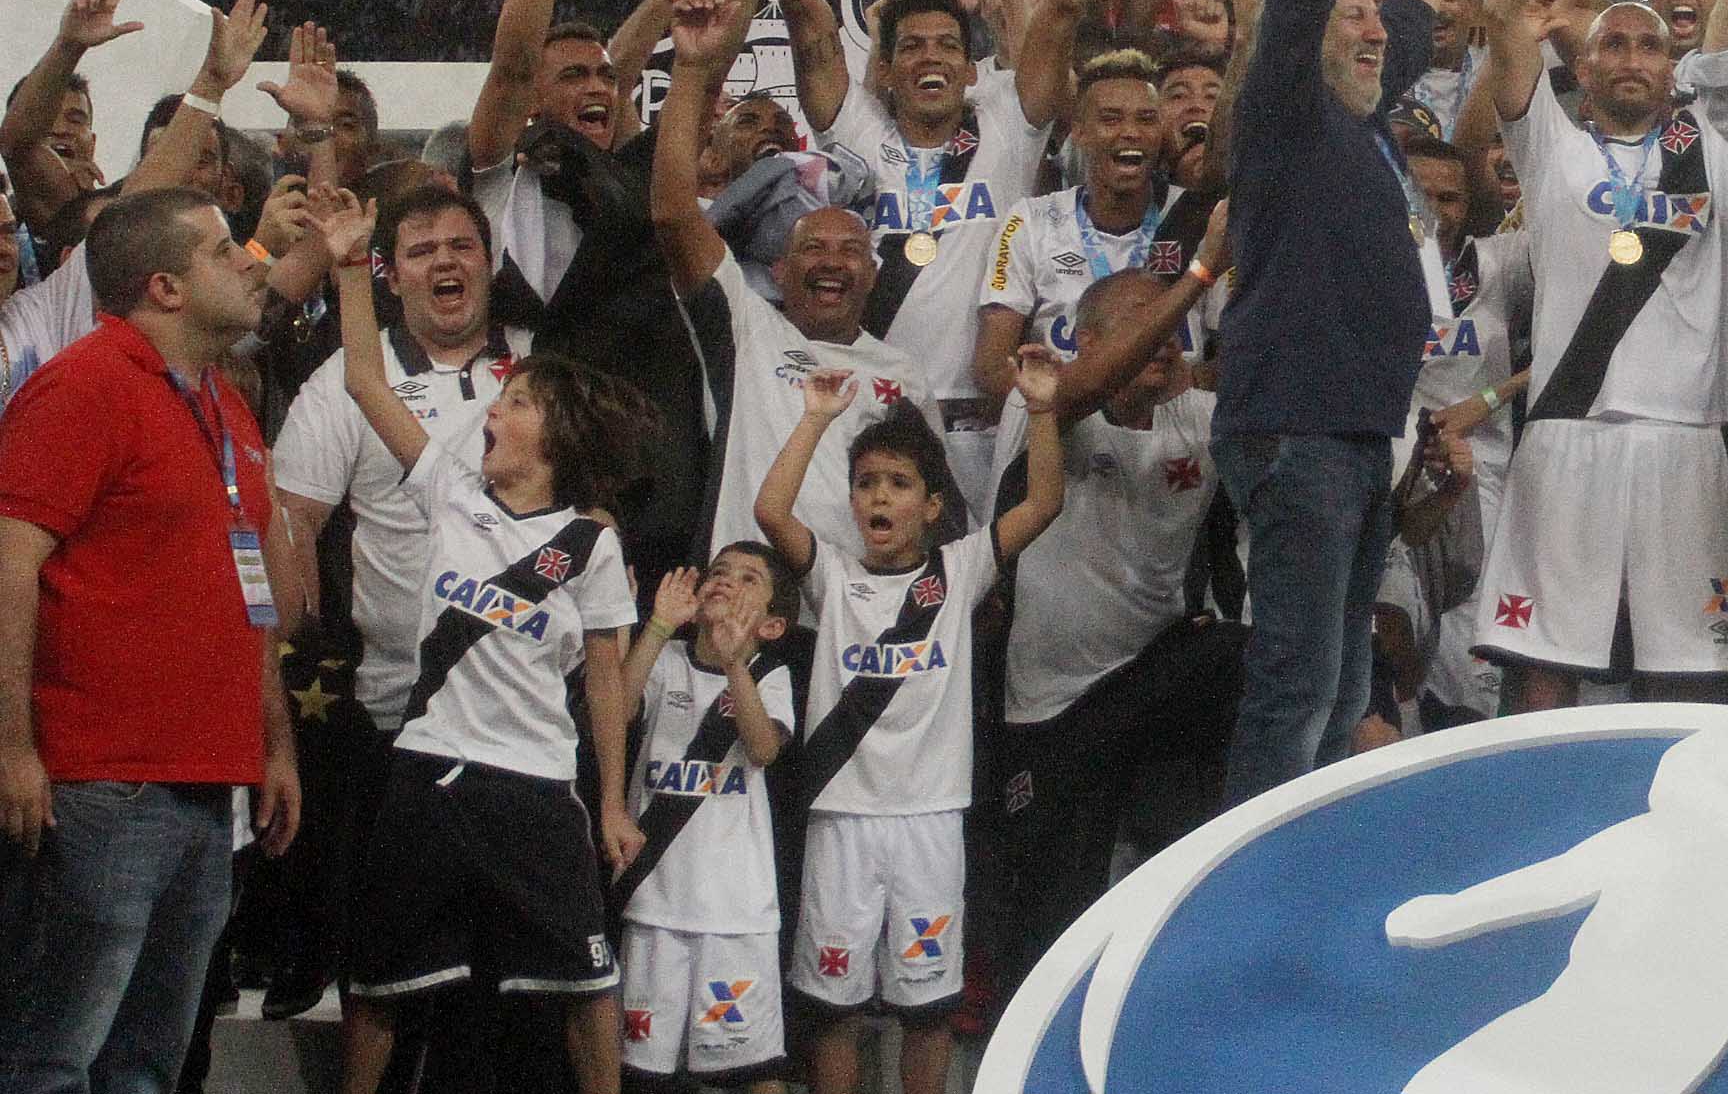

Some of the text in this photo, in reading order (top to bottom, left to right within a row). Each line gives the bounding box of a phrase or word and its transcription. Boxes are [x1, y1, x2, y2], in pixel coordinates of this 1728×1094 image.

[1055, 267, 1085, 276] umbro
[434, 570, 551, 641] CAIXA
[841, 639, 948, 675] CAIXA
[644, 760, 748, 795] CAIXA
